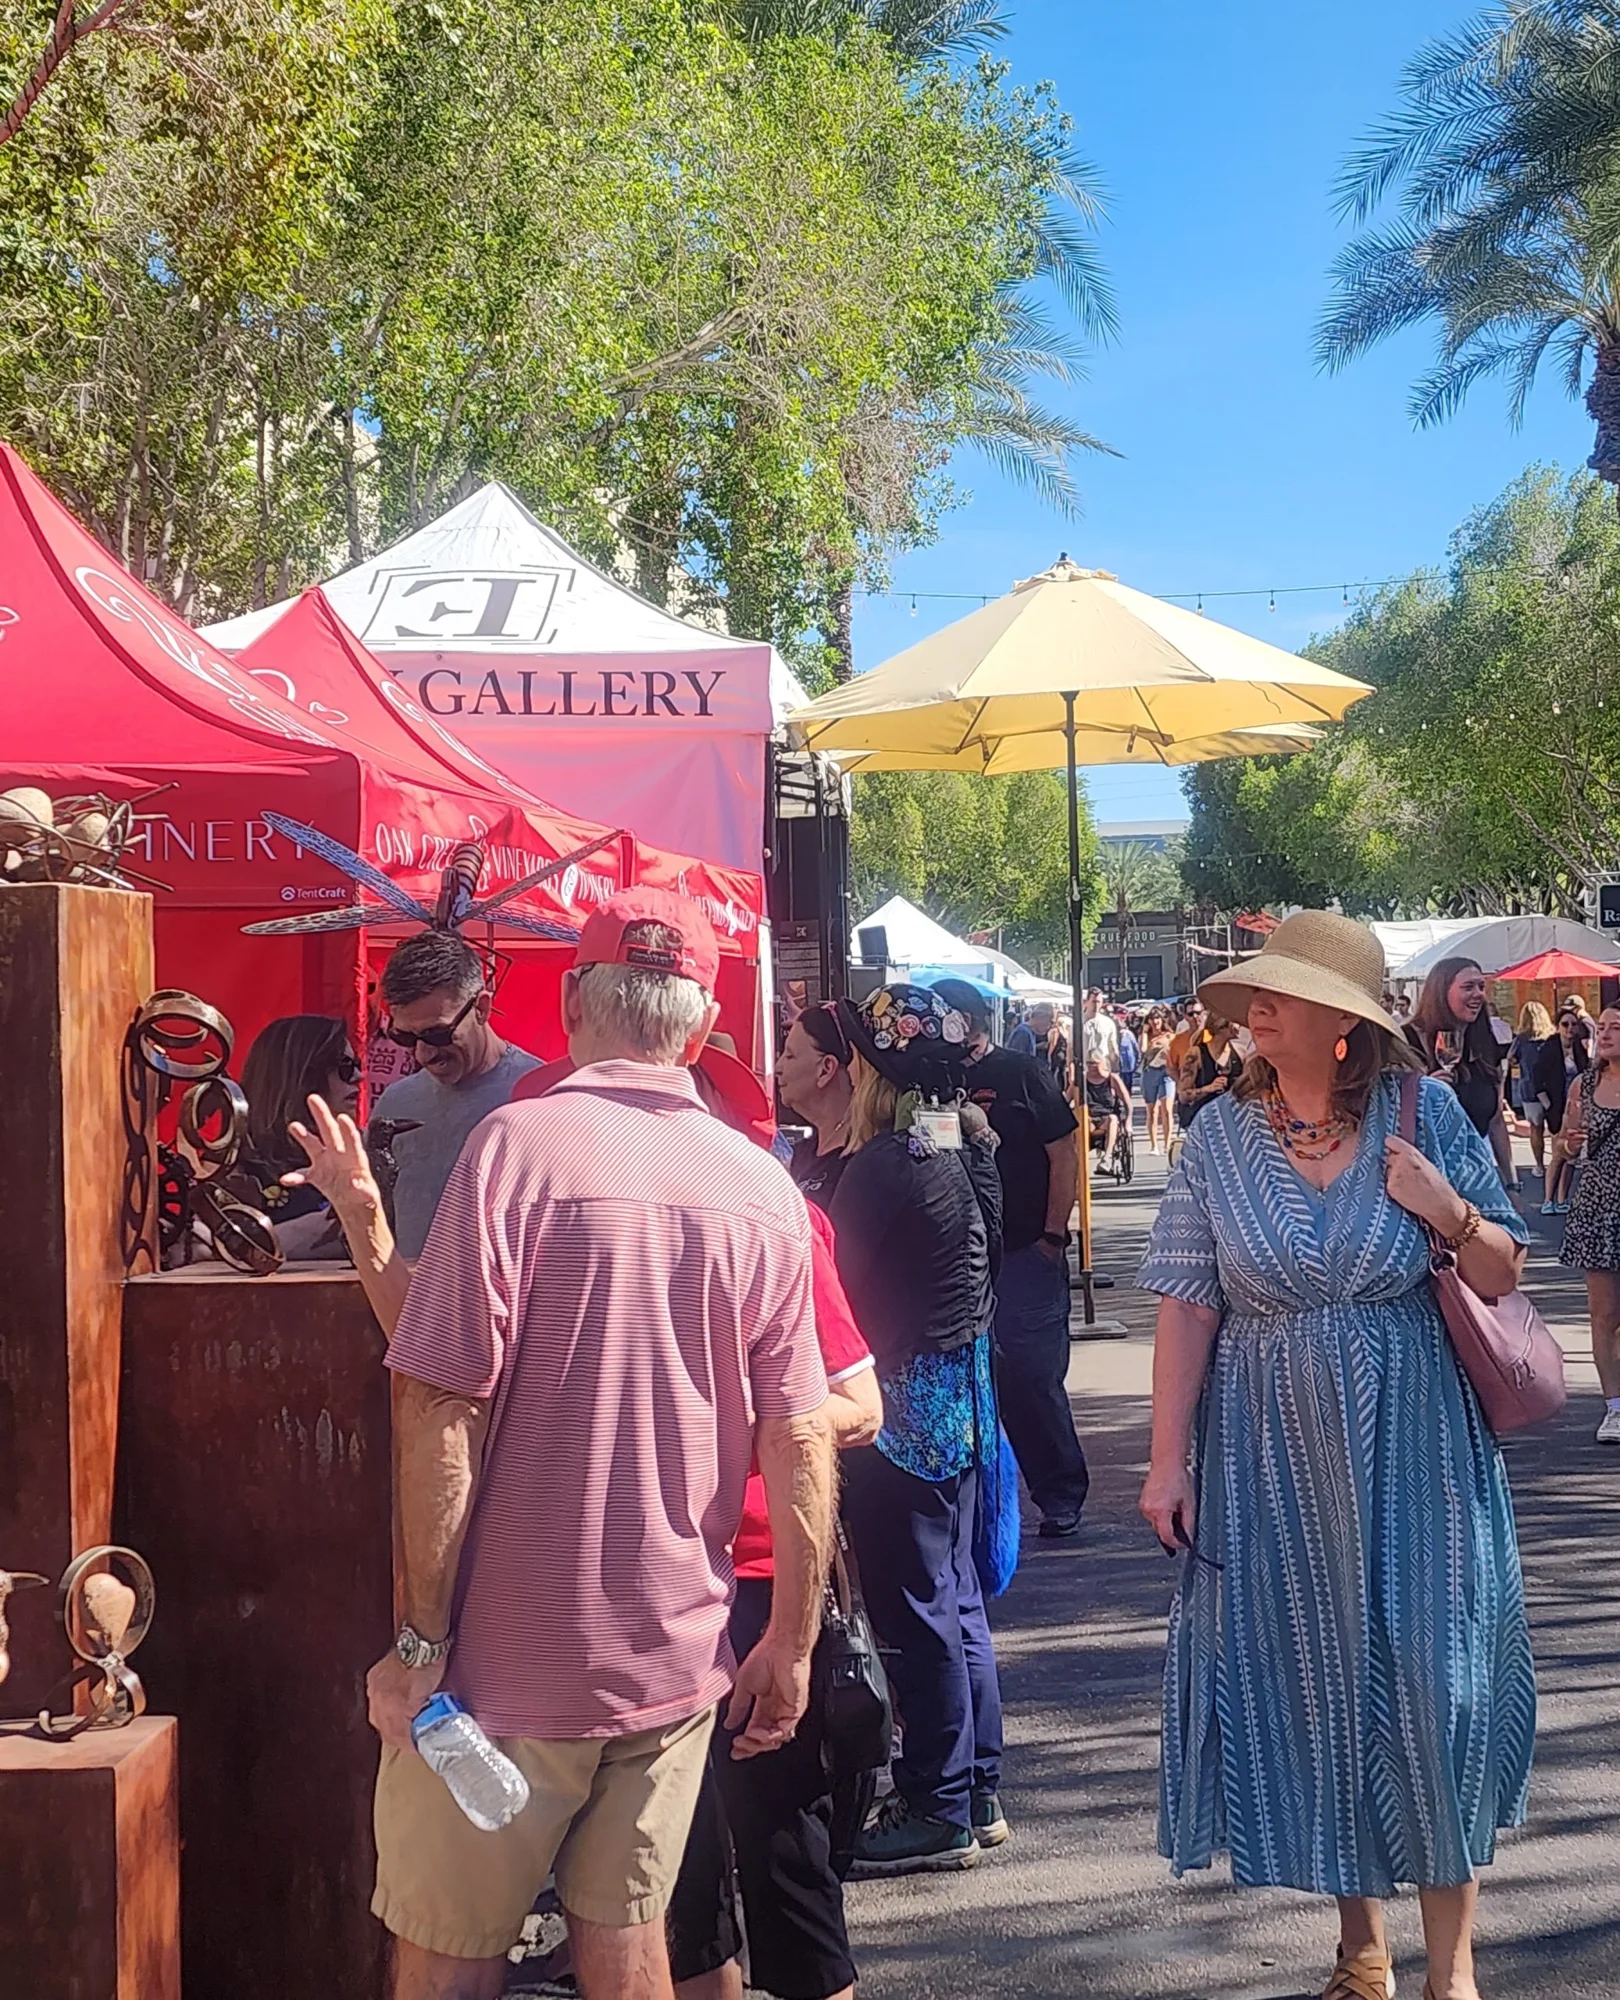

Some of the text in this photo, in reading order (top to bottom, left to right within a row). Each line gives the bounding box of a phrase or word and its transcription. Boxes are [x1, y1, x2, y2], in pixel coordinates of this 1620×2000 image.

[418, 668, 726, 717] GALLERY
[142, 820, 315, 862] INER
[375, 822, 414, 867] OAK
[418, 833, 462, 873] CREE
[297, 887, 347, 899] TentCraft
[1094, 932, 1155, 942] TRUE FOOD
